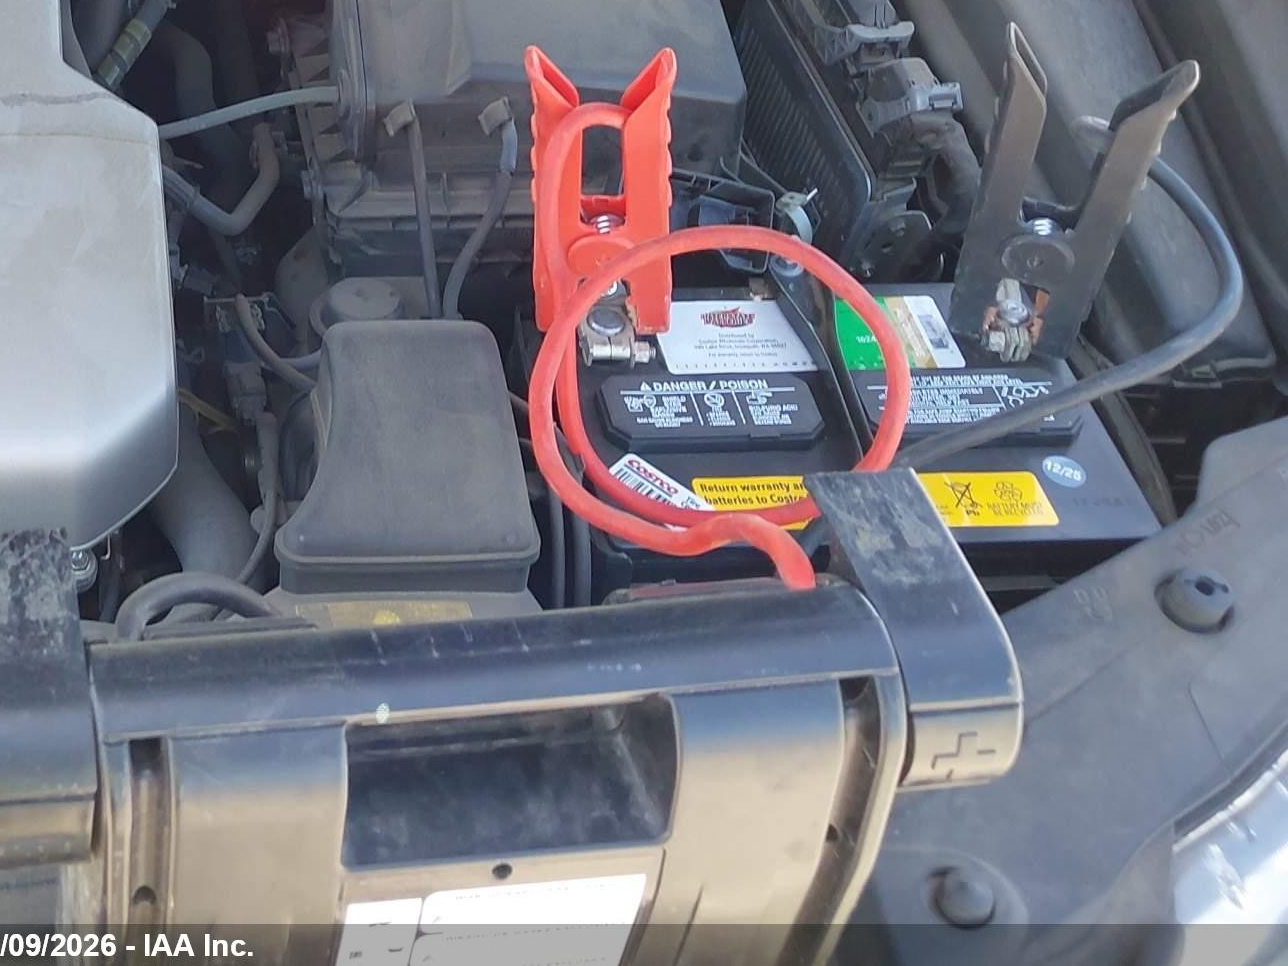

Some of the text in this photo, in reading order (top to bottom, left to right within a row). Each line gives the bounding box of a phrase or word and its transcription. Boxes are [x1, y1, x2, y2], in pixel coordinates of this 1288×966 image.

[652, 379, 769, 392] DANGER / POISON
[700, 483, 738, 493] Return
[741, 482, 790, 493] warranty
[704, 495, 753, 505] batteries
[756, 495, 768, 504] to
